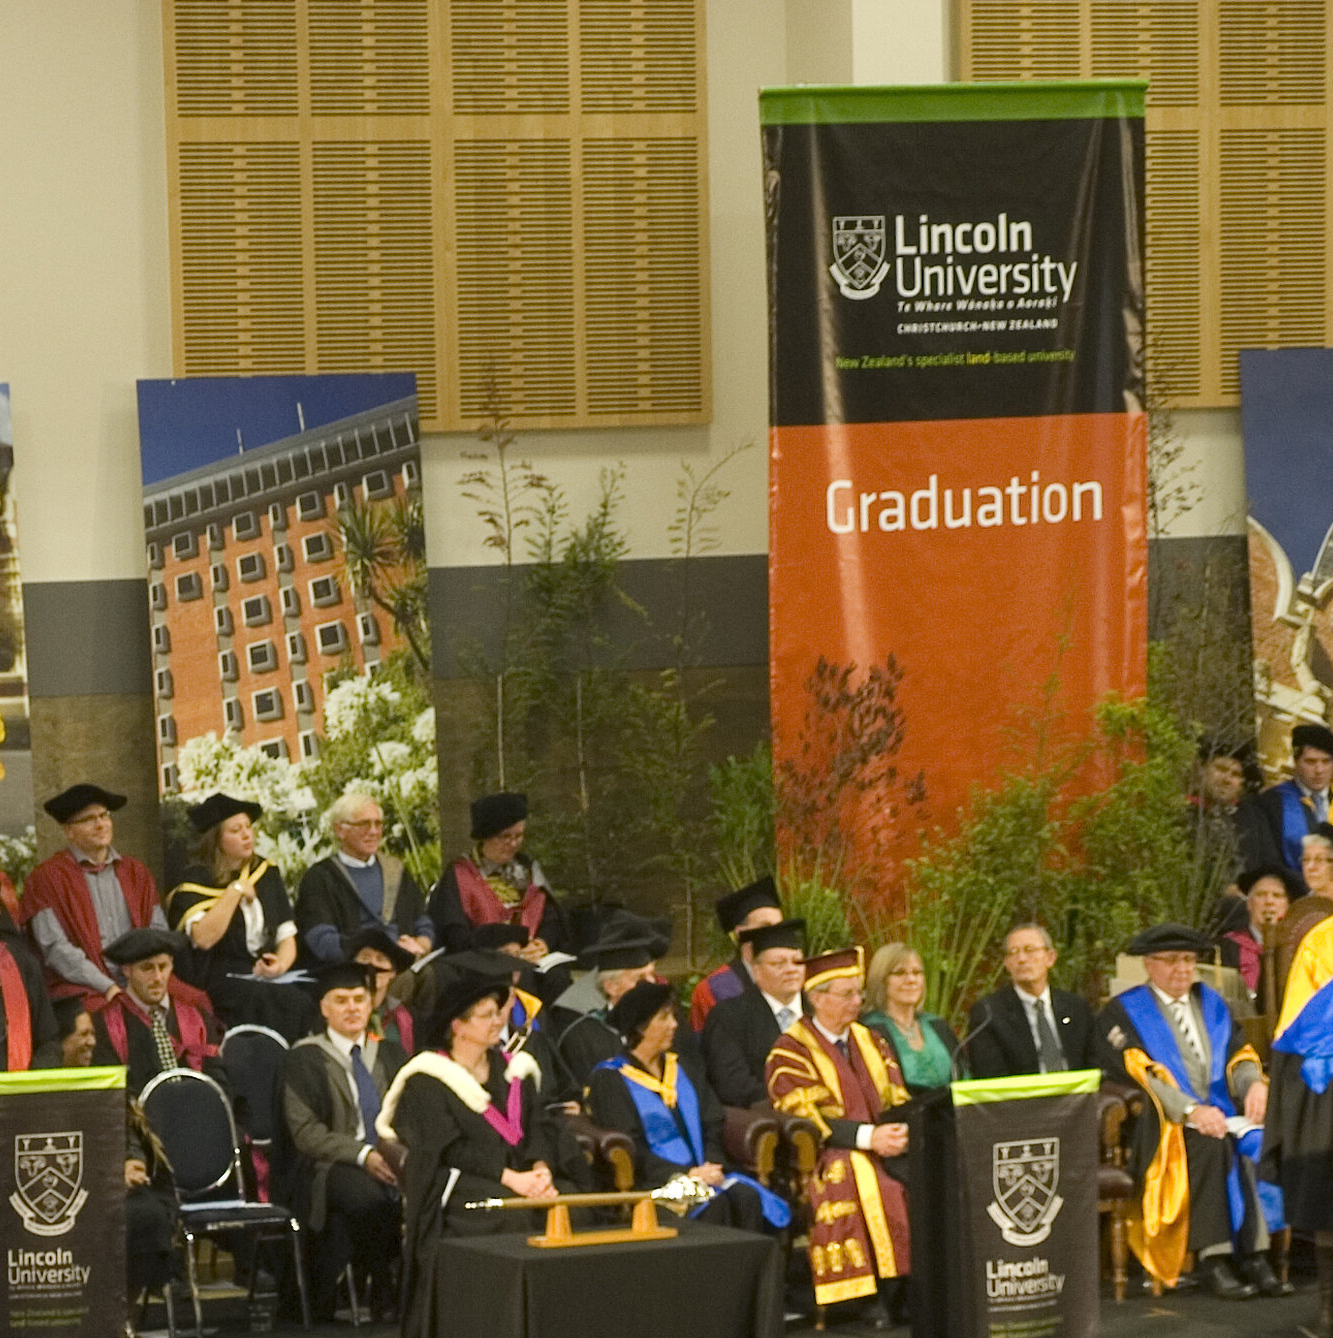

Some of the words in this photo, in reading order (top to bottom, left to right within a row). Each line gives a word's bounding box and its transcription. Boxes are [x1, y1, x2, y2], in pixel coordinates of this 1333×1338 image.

[895, 212, 1033, 255] Lincoln
[896, 253, 1078, 303] University
[1008, 318, 1058, 331] ZEALAND
[826, 470, 1103, 534] Graduation
[8, 1247, 73, 1267] Lincoln
[986, 1256, 1048, 1279] Lincoln
[8, 1264, 91, 1285] University
[987, 1272, 1065, 1298] University
